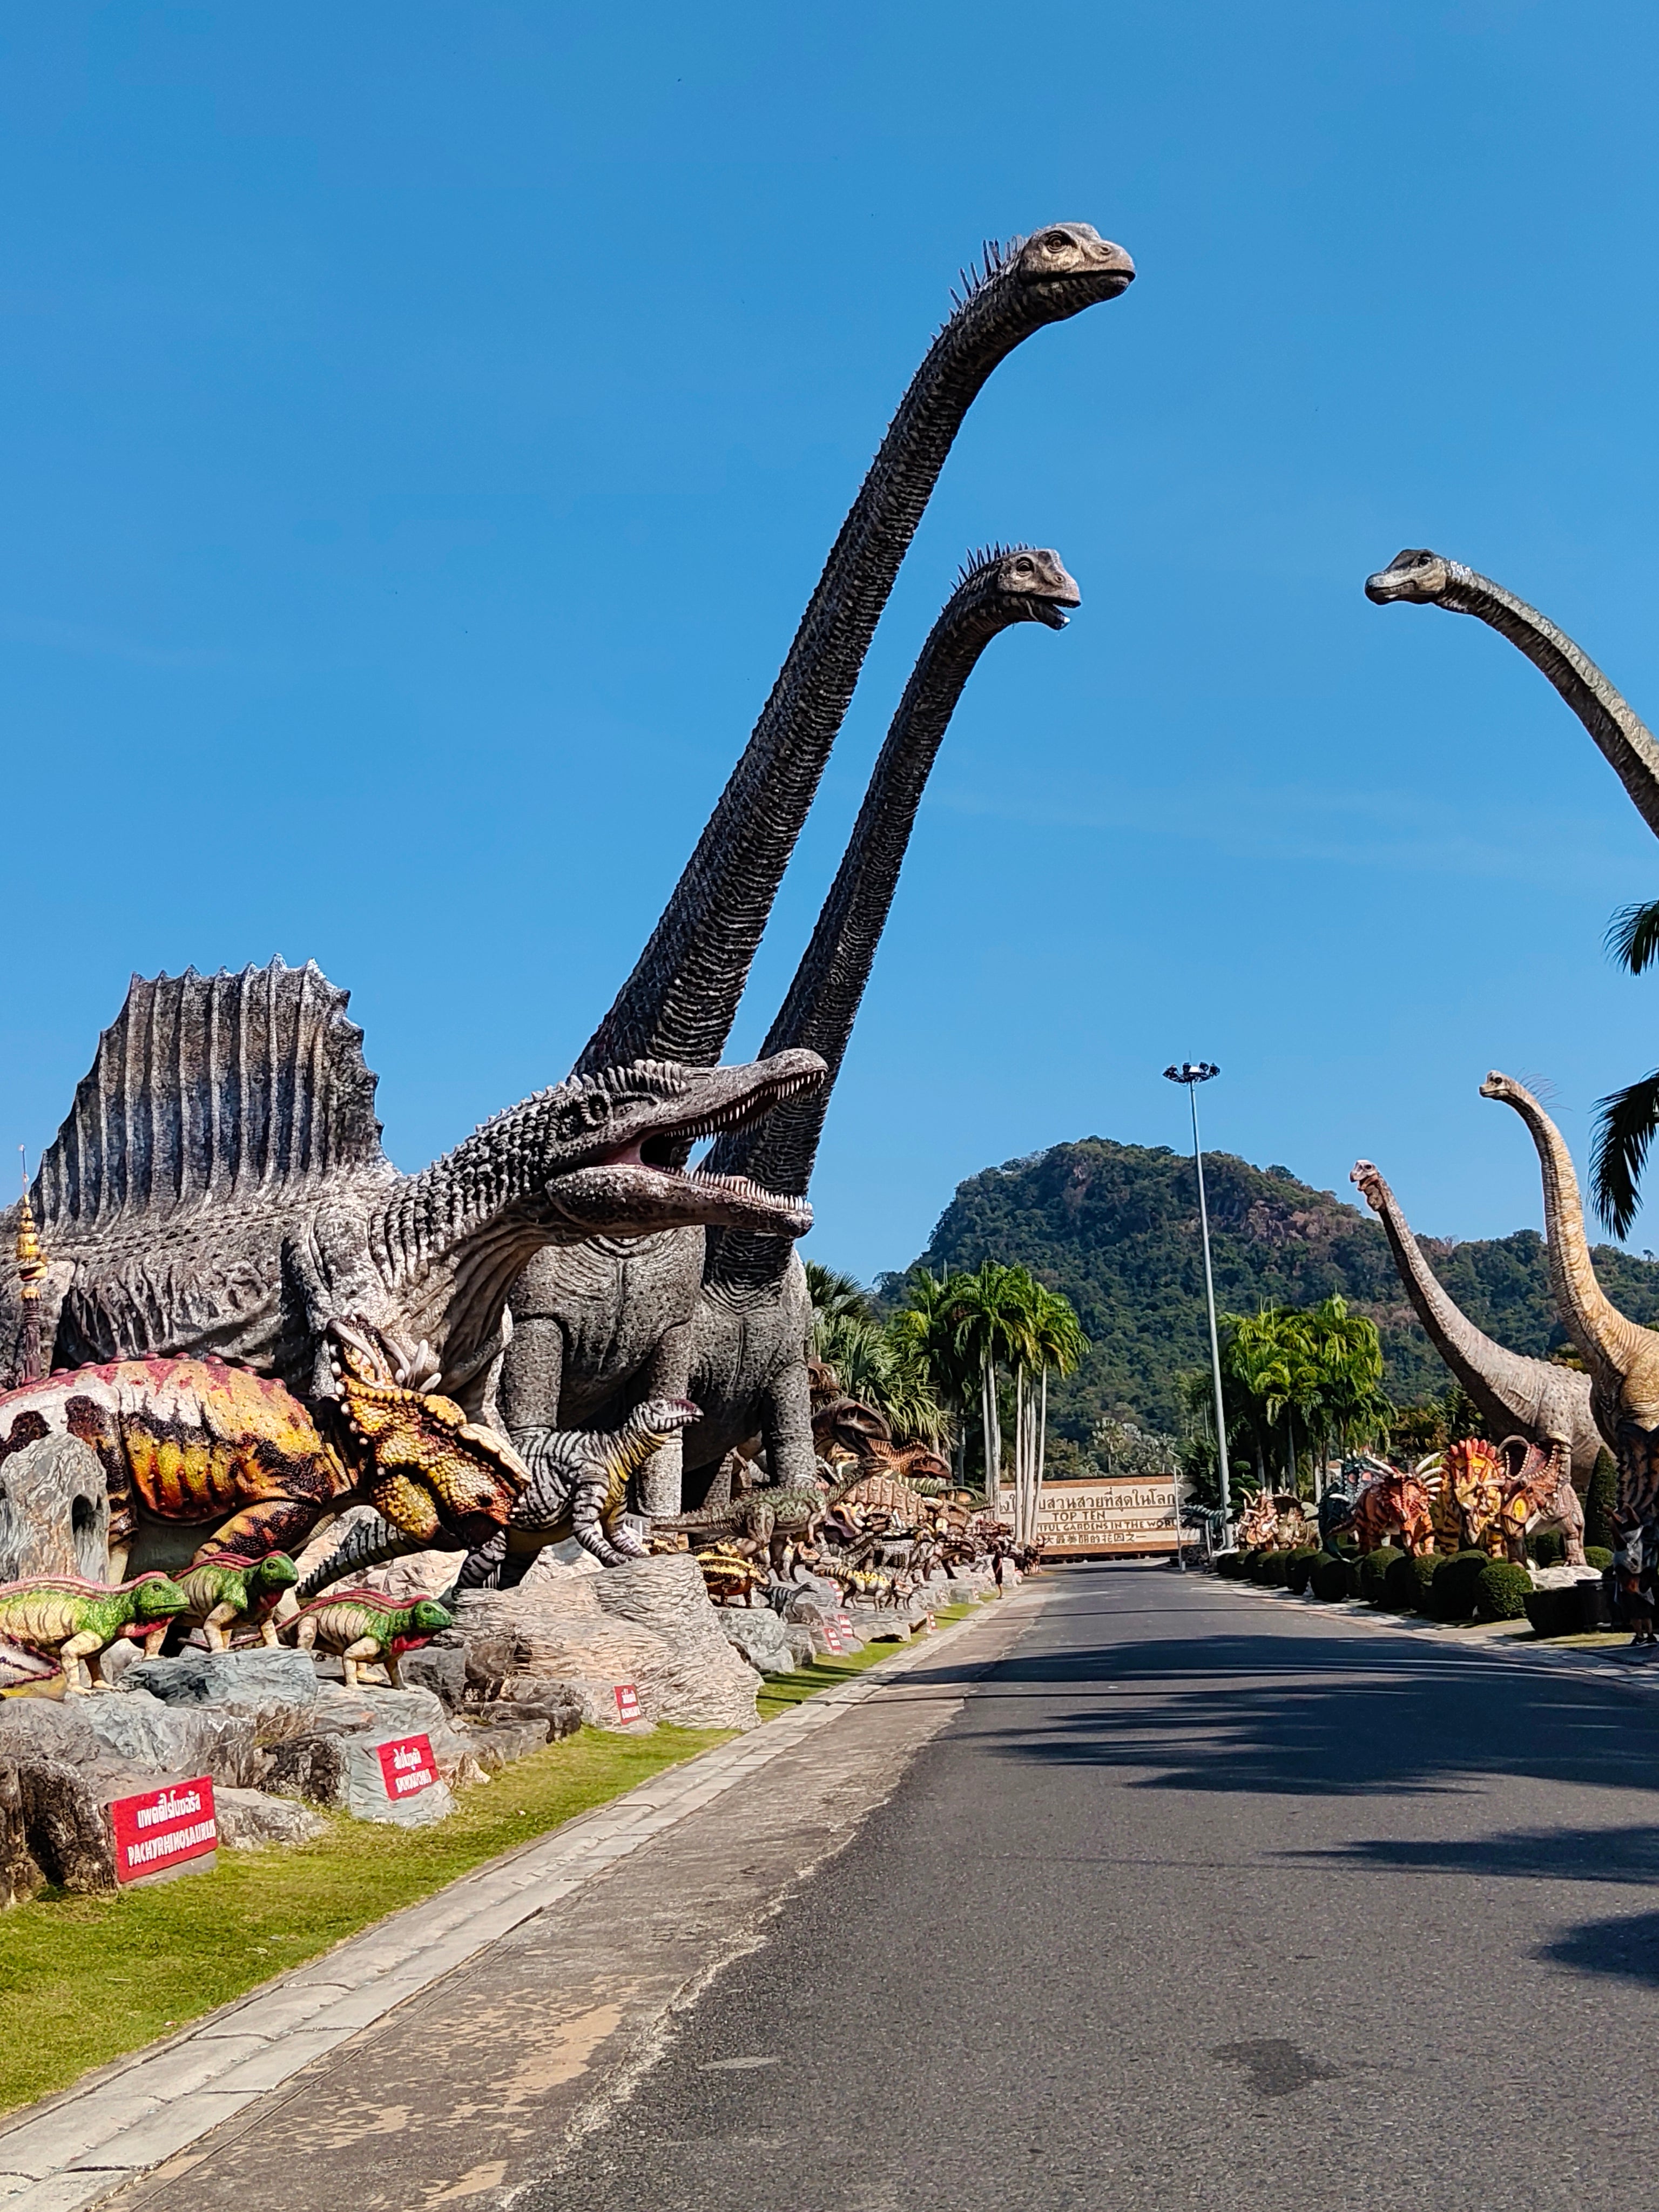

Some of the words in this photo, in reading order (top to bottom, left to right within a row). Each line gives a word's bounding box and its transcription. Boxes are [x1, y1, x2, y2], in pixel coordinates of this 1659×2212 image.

[1052, 1512, 1077, 1522] TOP
[1082, 1510, 1105, 1520] TEN
[1063, 1522, 1108, 1531] GARDENS
[1124, 1520, 1144, 1529] THE
[1147, 1518, 1177, 1527] WORL
[127, 1818, 217, 1867] PACHYRHINOSAURUS
